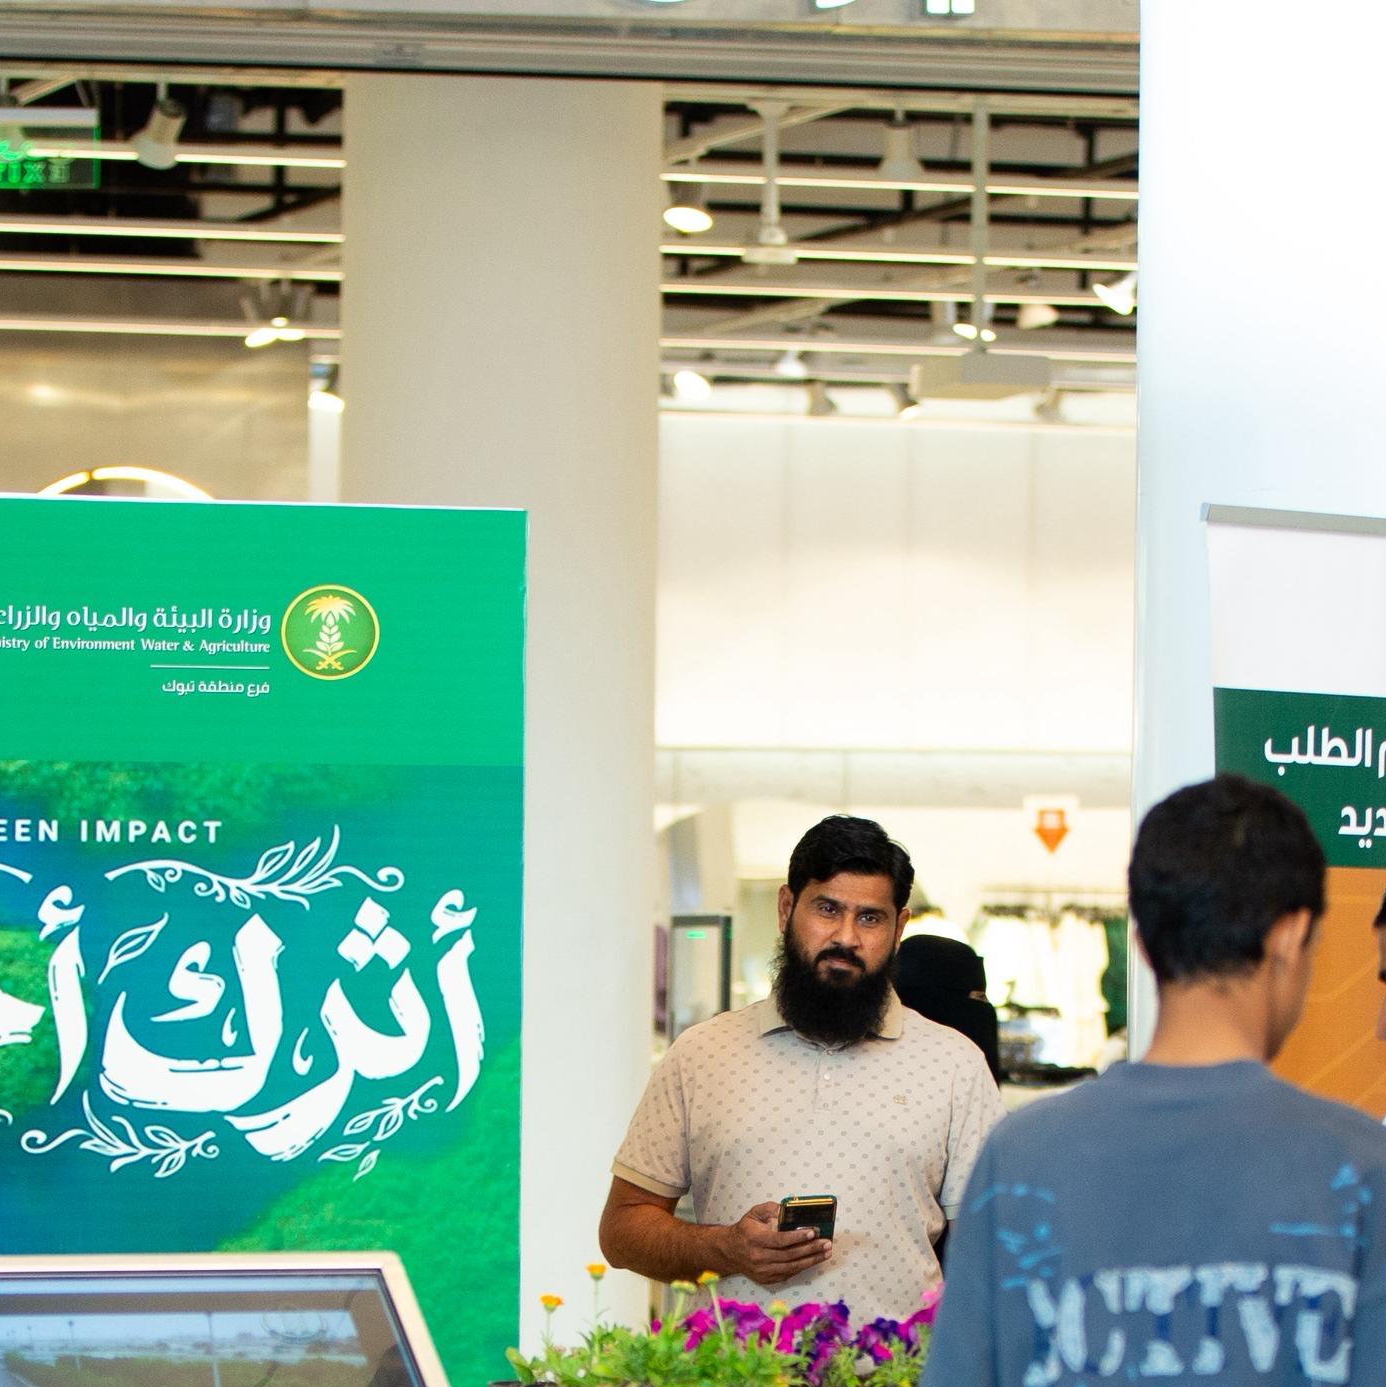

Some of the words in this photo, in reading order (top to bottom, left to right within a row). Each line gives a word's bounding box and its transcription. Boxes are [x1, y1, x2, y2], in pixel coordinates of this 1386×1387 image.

[67, 606, 147, 632] والمياه
[153, 606, 212, 634] البيئة
[218, 608, 271, 634] وزارة
[34, 635, 49, 649] of
[53, 637, 135, 651] Environment
[141, 639, 179, 652] Water
[182, 641, 195, 652] &
[198, 641, 271, 655] Agriculture
[162, 680, 195, 696] تبوك
[198, 679, 244, 693] منطقة
[247, 682, 270, 697] فرع
[1264, 725, 1373, 777] الطلب
[80, 820, 223, 844] IMPACT
[99, 888, 486, 1162] أثرك
